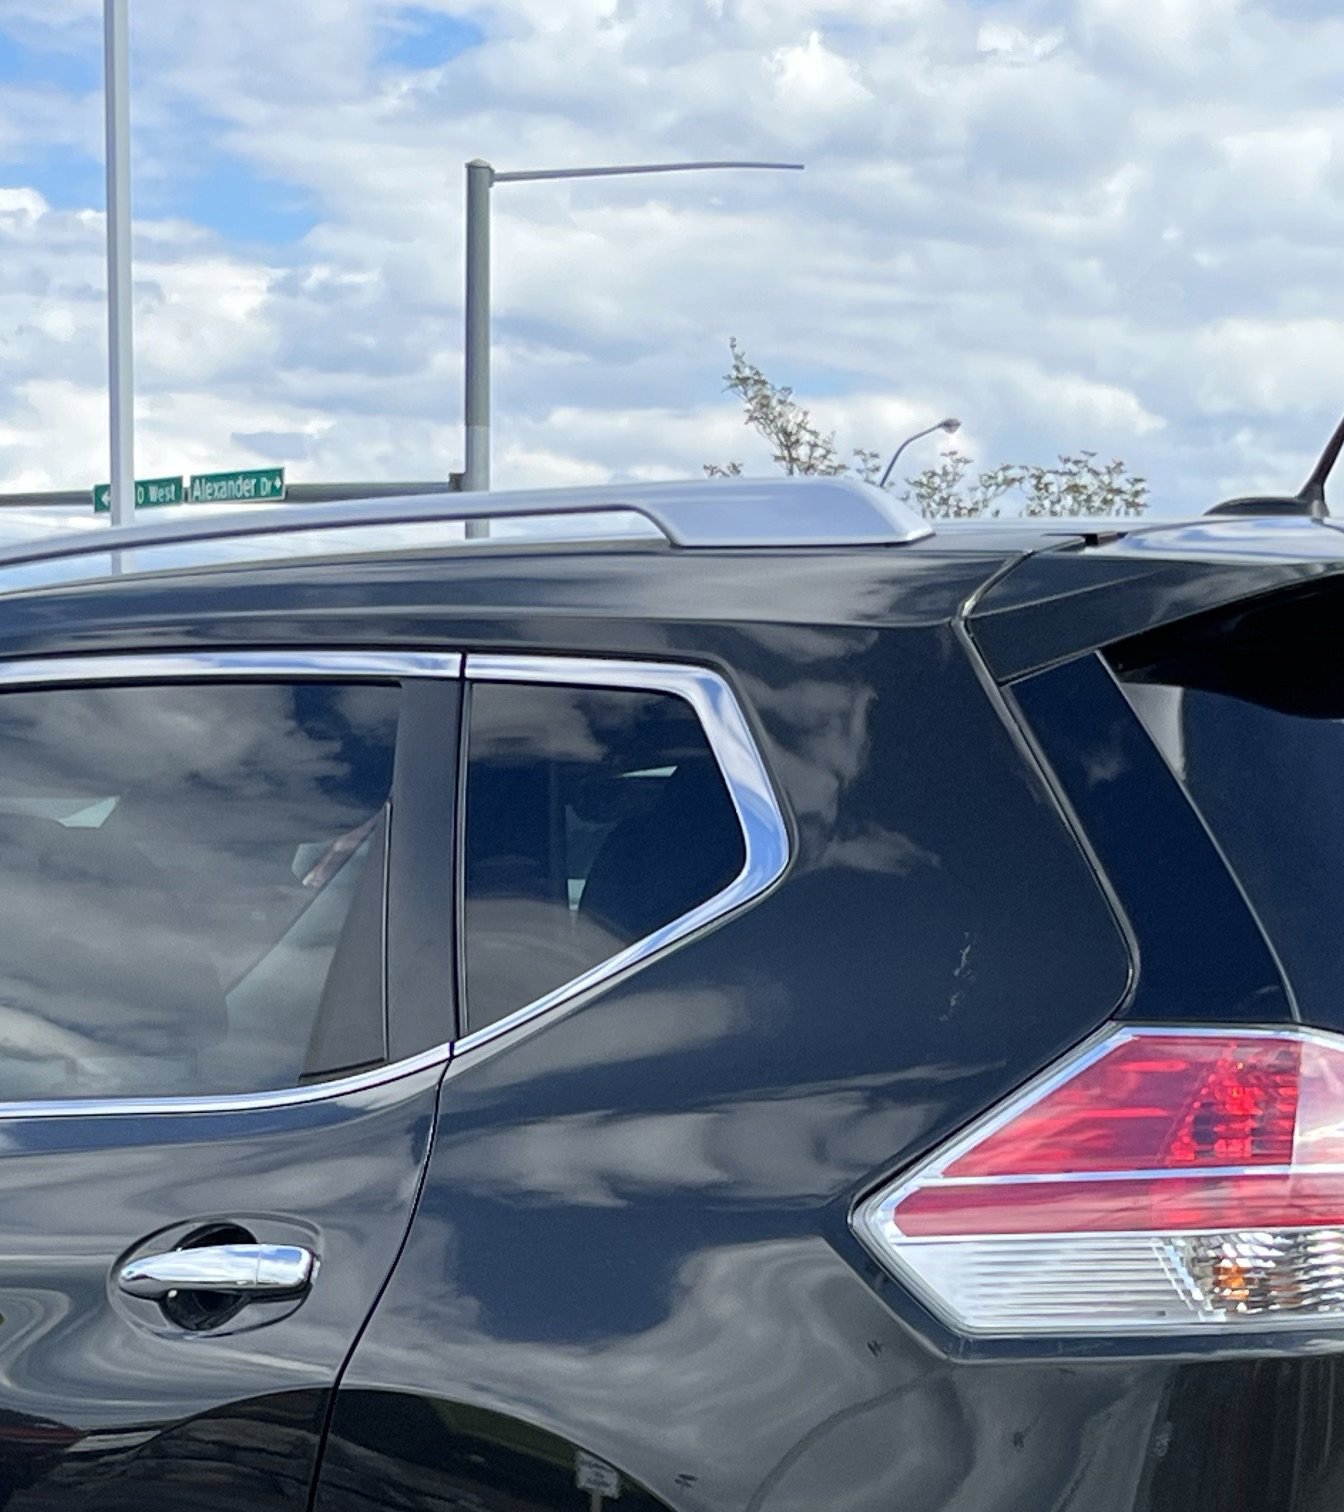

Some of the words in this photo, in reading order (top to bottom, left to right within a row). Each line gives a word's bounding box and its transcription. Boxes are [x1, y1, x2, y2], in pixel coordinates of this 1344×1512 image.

[149, 483, 176, 502] West
[192, 474, 257, 500] Alexander
[260, 477, 273, 497] Dr
